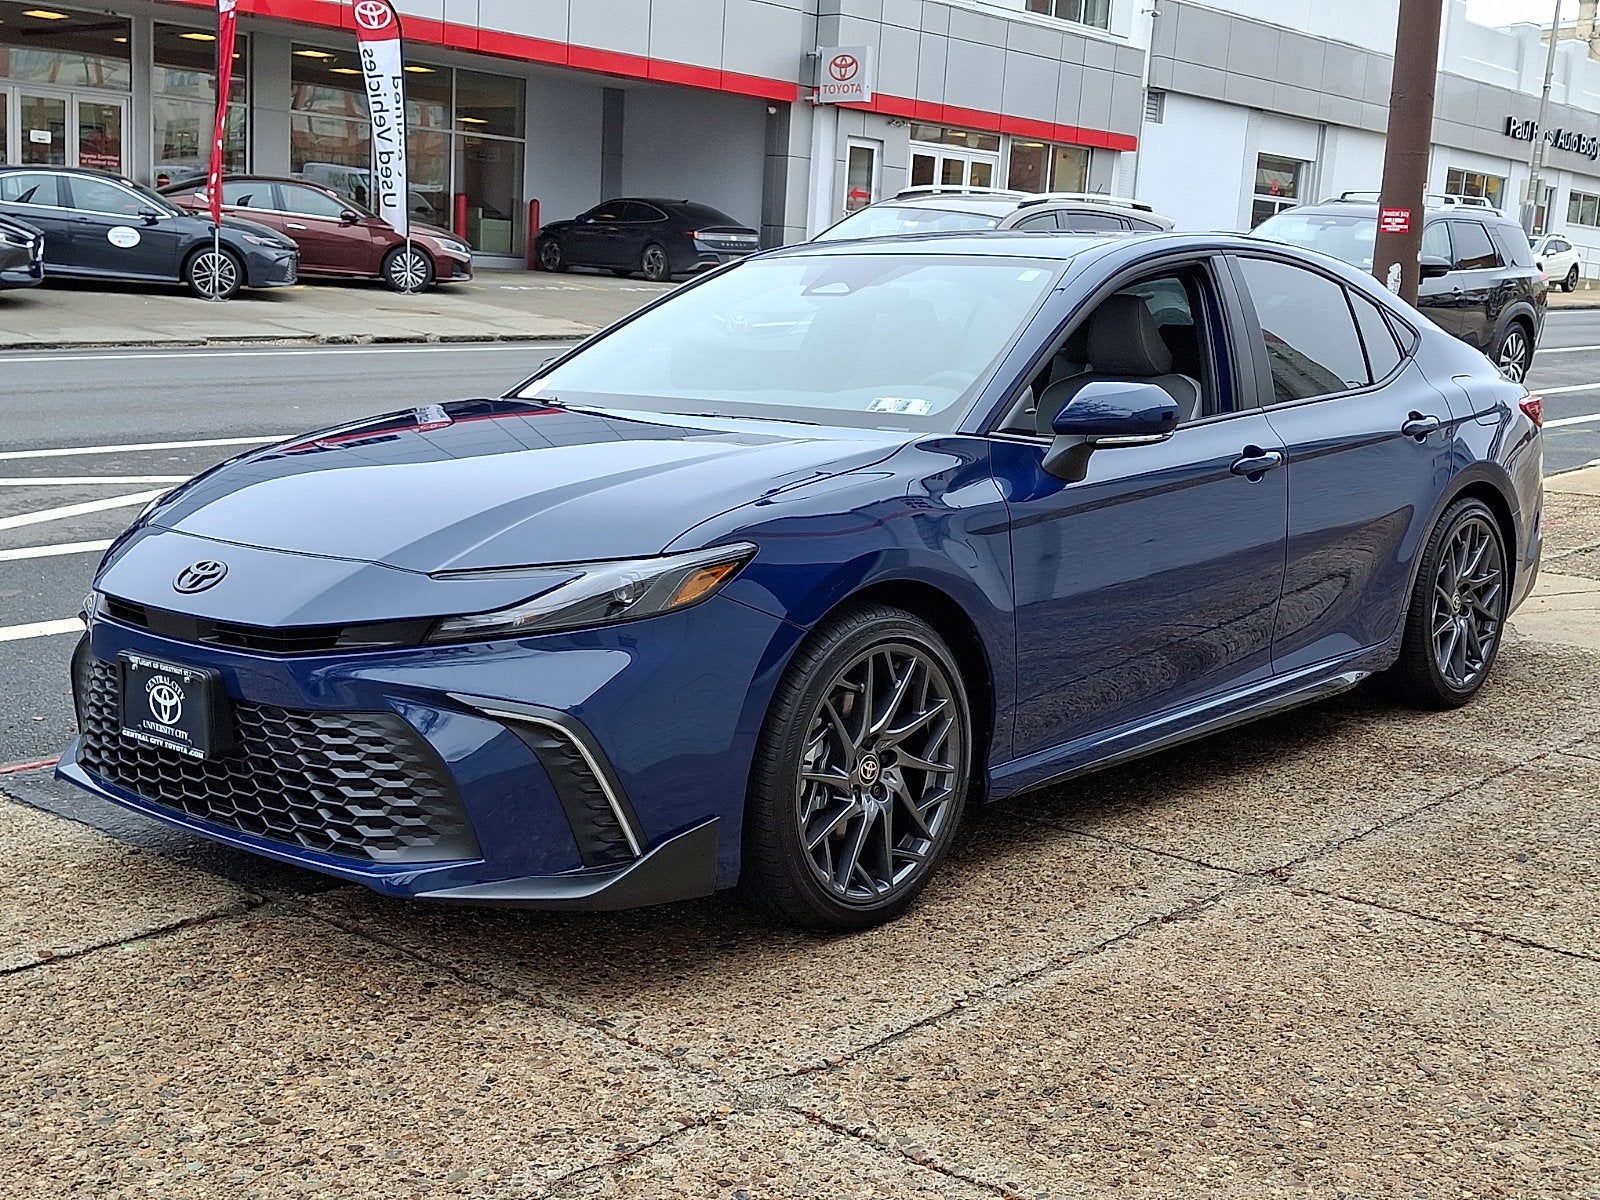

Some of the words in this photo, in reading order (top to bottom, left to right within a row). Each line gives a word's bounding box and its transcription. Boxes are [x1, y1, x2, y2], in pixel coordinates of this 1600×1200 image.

[823, 83, 862, 95] TOYOTA
[1506, 115, 1531, 141] Paul
[1555, 128, 1578, 152] Auto
[145, 675, 171, 692] CENTRAL
[171, 681, 187, 701] CITY
[122, 729, 149, 742] CENTRAL
[149, 737, 164, 746] CITY
[164, 742, 188, 754] TOYOTA
[142, 719, 175, 736] UNIVERSITY
[175, 728, 189, 741] CITY
